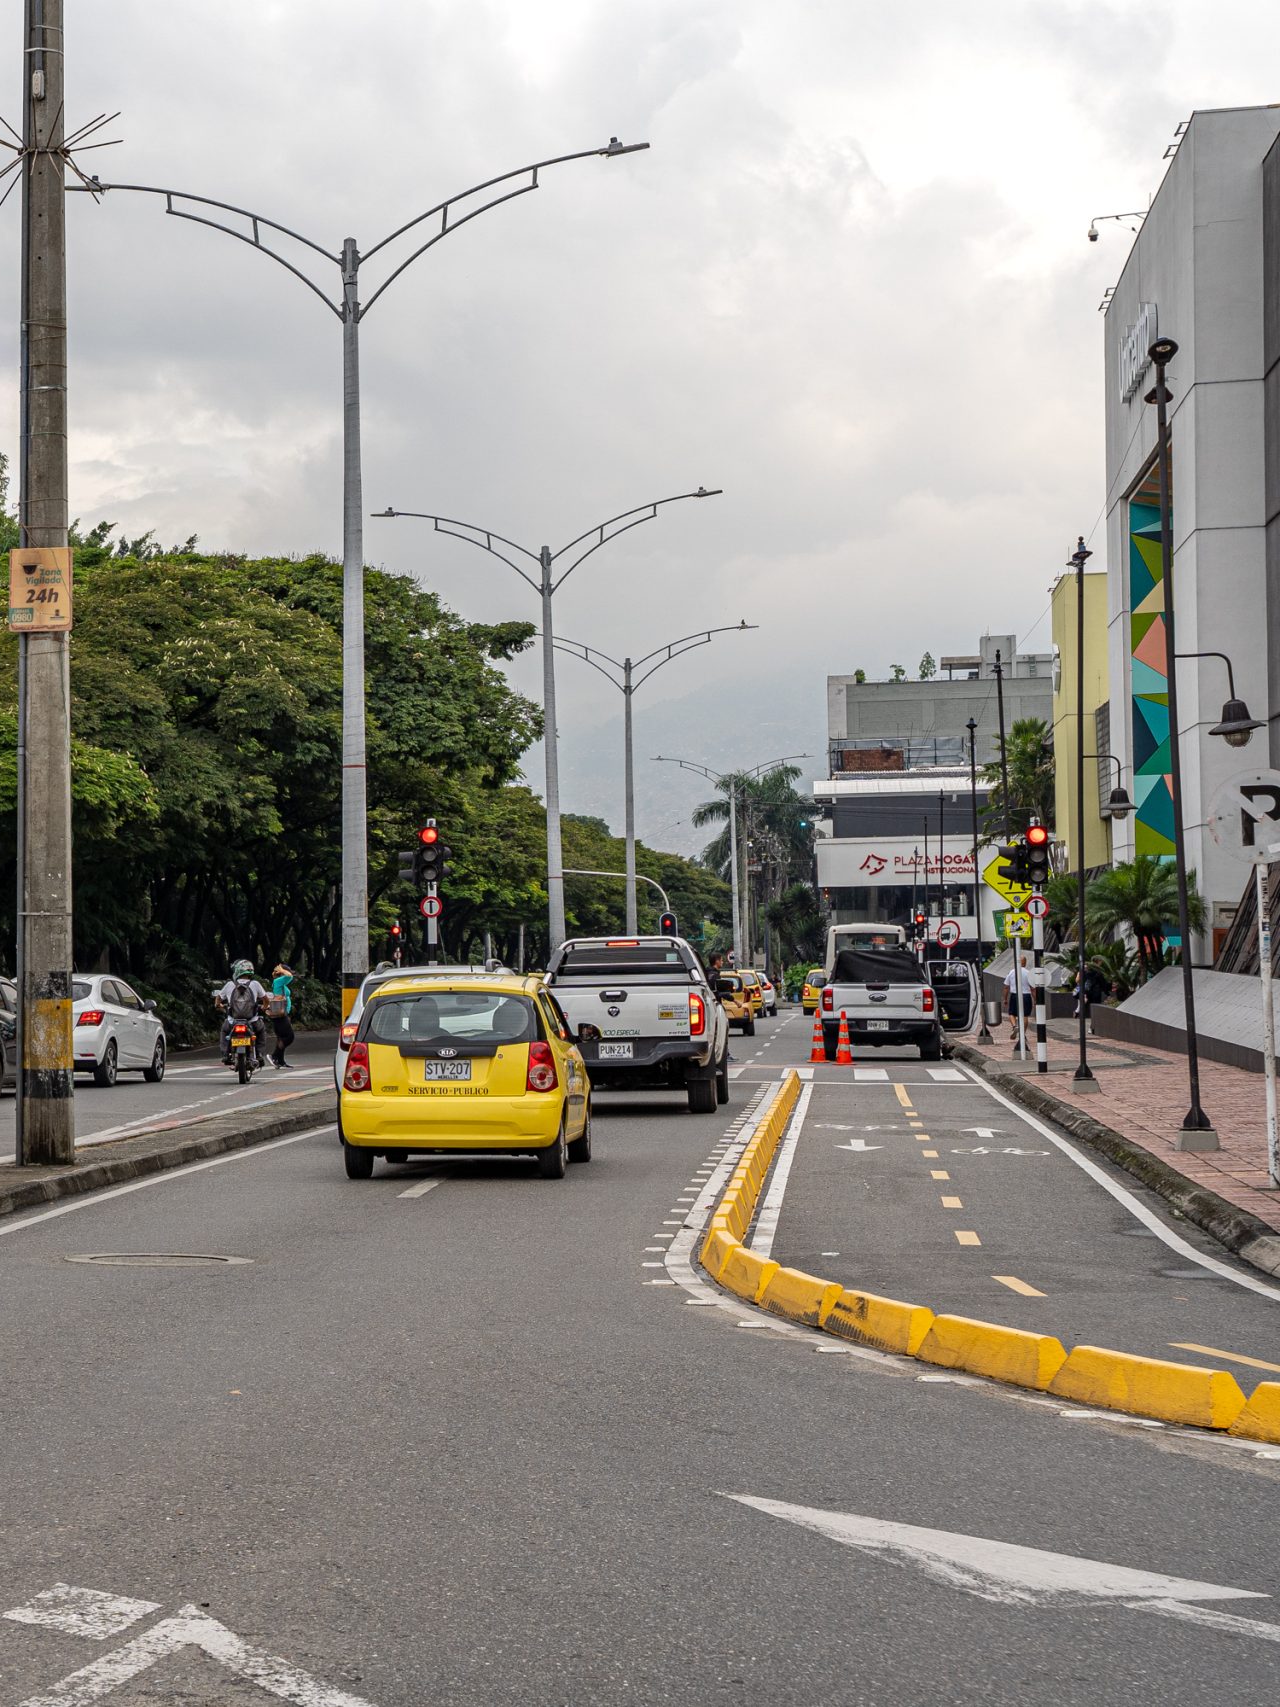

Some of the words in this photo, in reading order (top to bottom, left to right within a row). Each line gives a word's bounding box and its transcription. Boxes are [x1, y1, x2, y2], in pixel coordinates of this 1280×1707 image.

[26, 576, 61, 585] Vigilada
[26, 588, 58, 603] 24h
[12, 613, 32, 622] 0980
[894, 855, 933, 866] PLAZA
[408, 1087, 448, 1095] SERVICIO
[453, 1087, 489, 1095] PUBLICO
